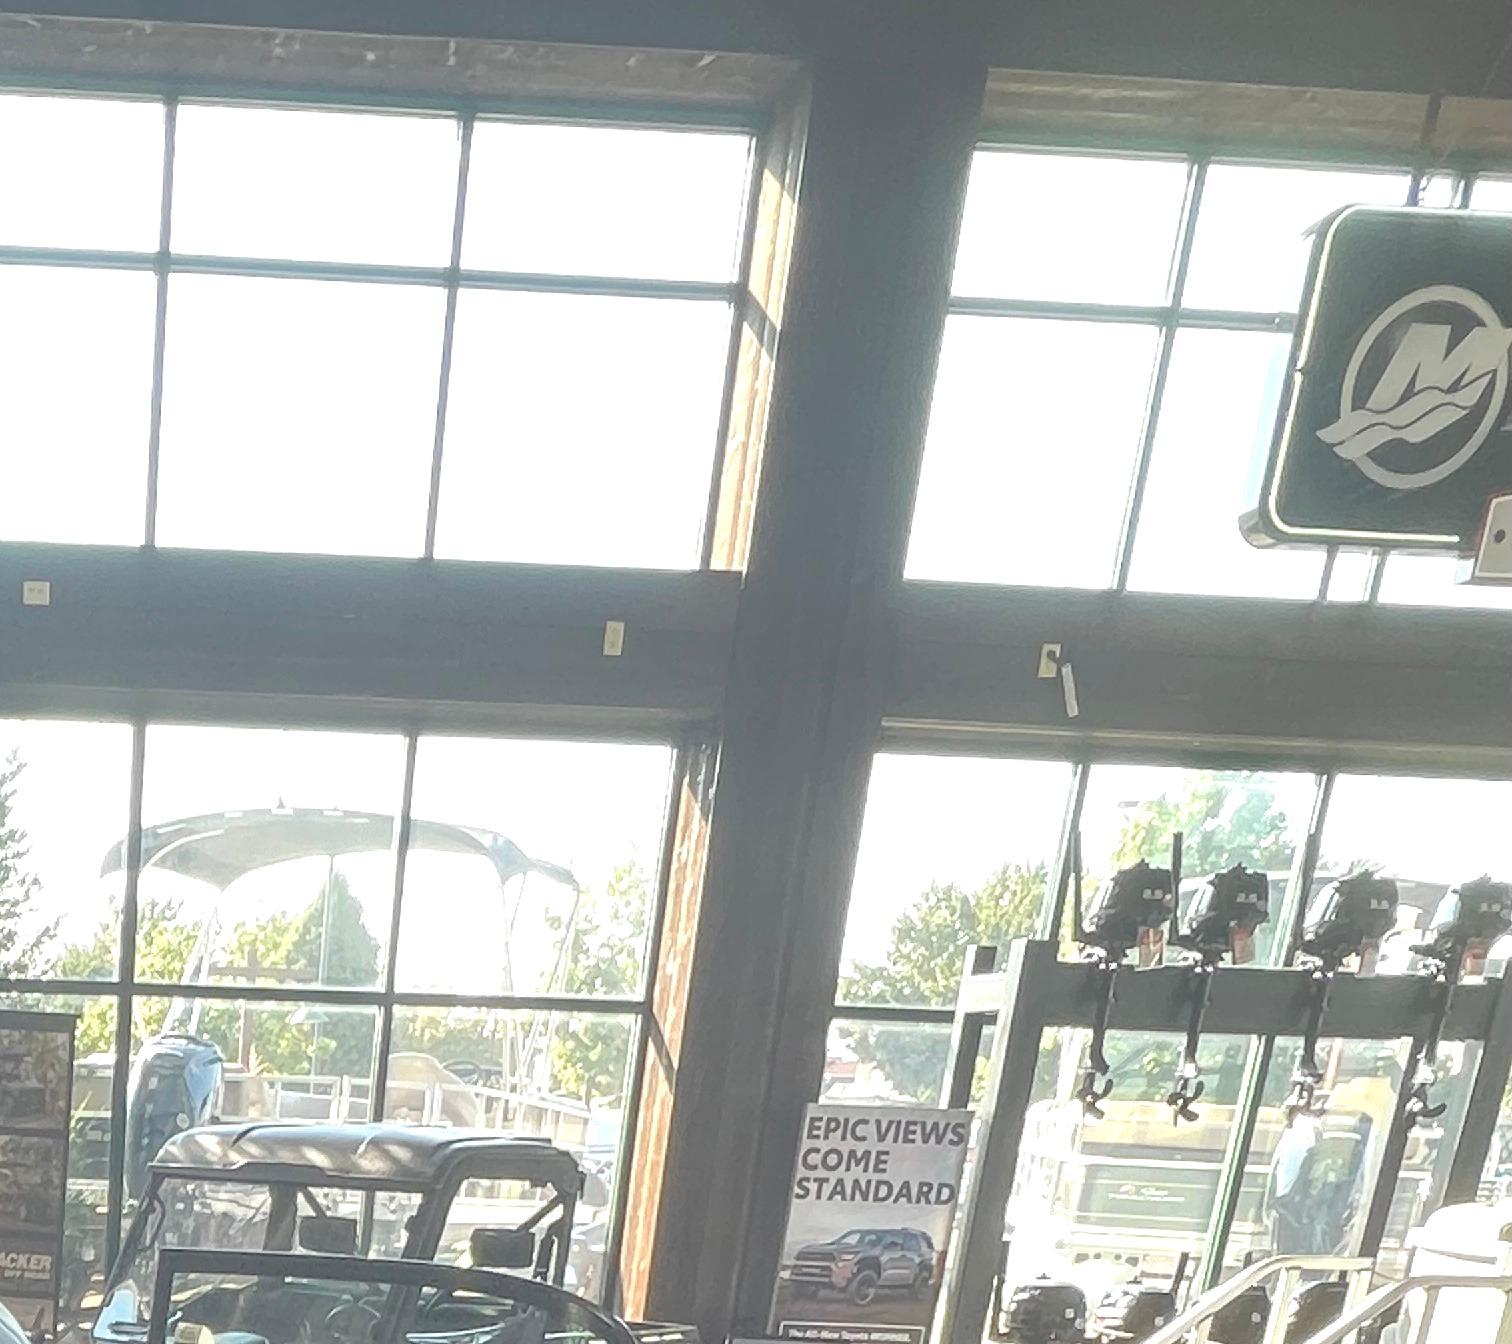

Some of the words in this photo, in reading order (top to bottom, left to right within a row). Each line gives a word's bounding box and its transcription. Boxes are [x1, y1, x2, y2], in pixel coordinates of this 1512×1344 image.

[806, 1116, 870, 1142] EPIC
[874, 1118, 966, 1147] VIEWS
[801, 1147, 890, 1174] COME
[794, 1177, 956, 1206] STANDARD
